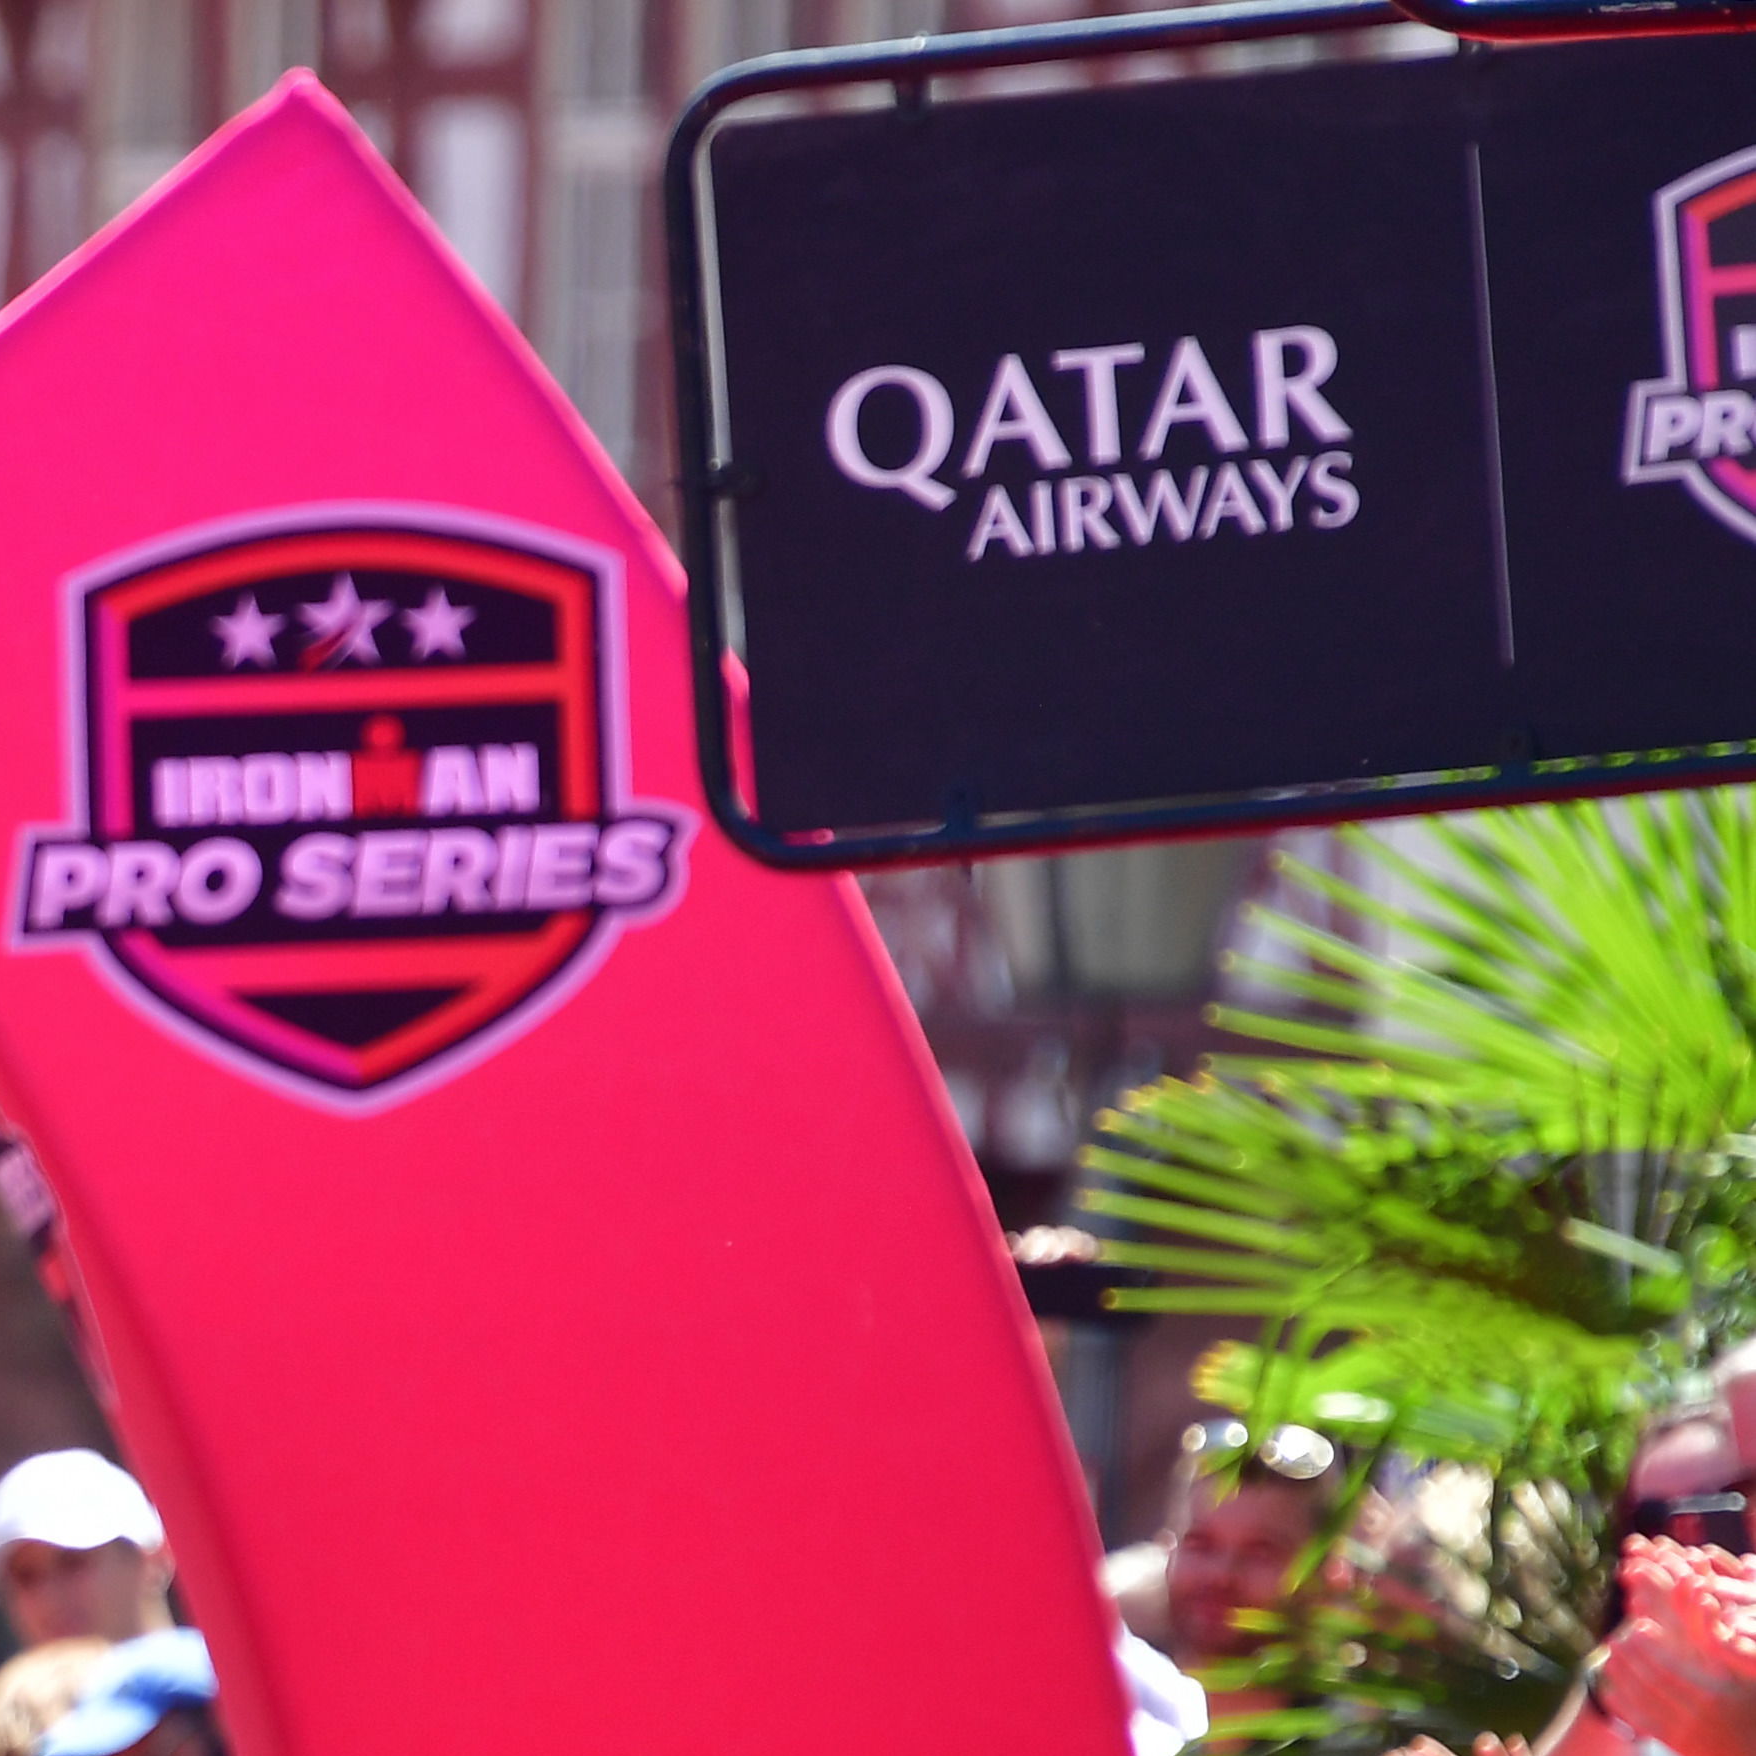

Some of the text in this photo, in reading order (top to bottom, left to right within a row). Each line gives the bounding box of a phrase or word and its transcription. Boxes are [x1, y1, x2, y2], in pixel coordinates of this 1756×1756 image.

[825, 323, 1354, 511] QATAR
[1643, 389, 1756, 462] PR
[967, 450, 1362, 563] AIRWAYS
[151, 720, 542, 828] IRONMAN
[27, 817, 673, 930] PRO SERIES
